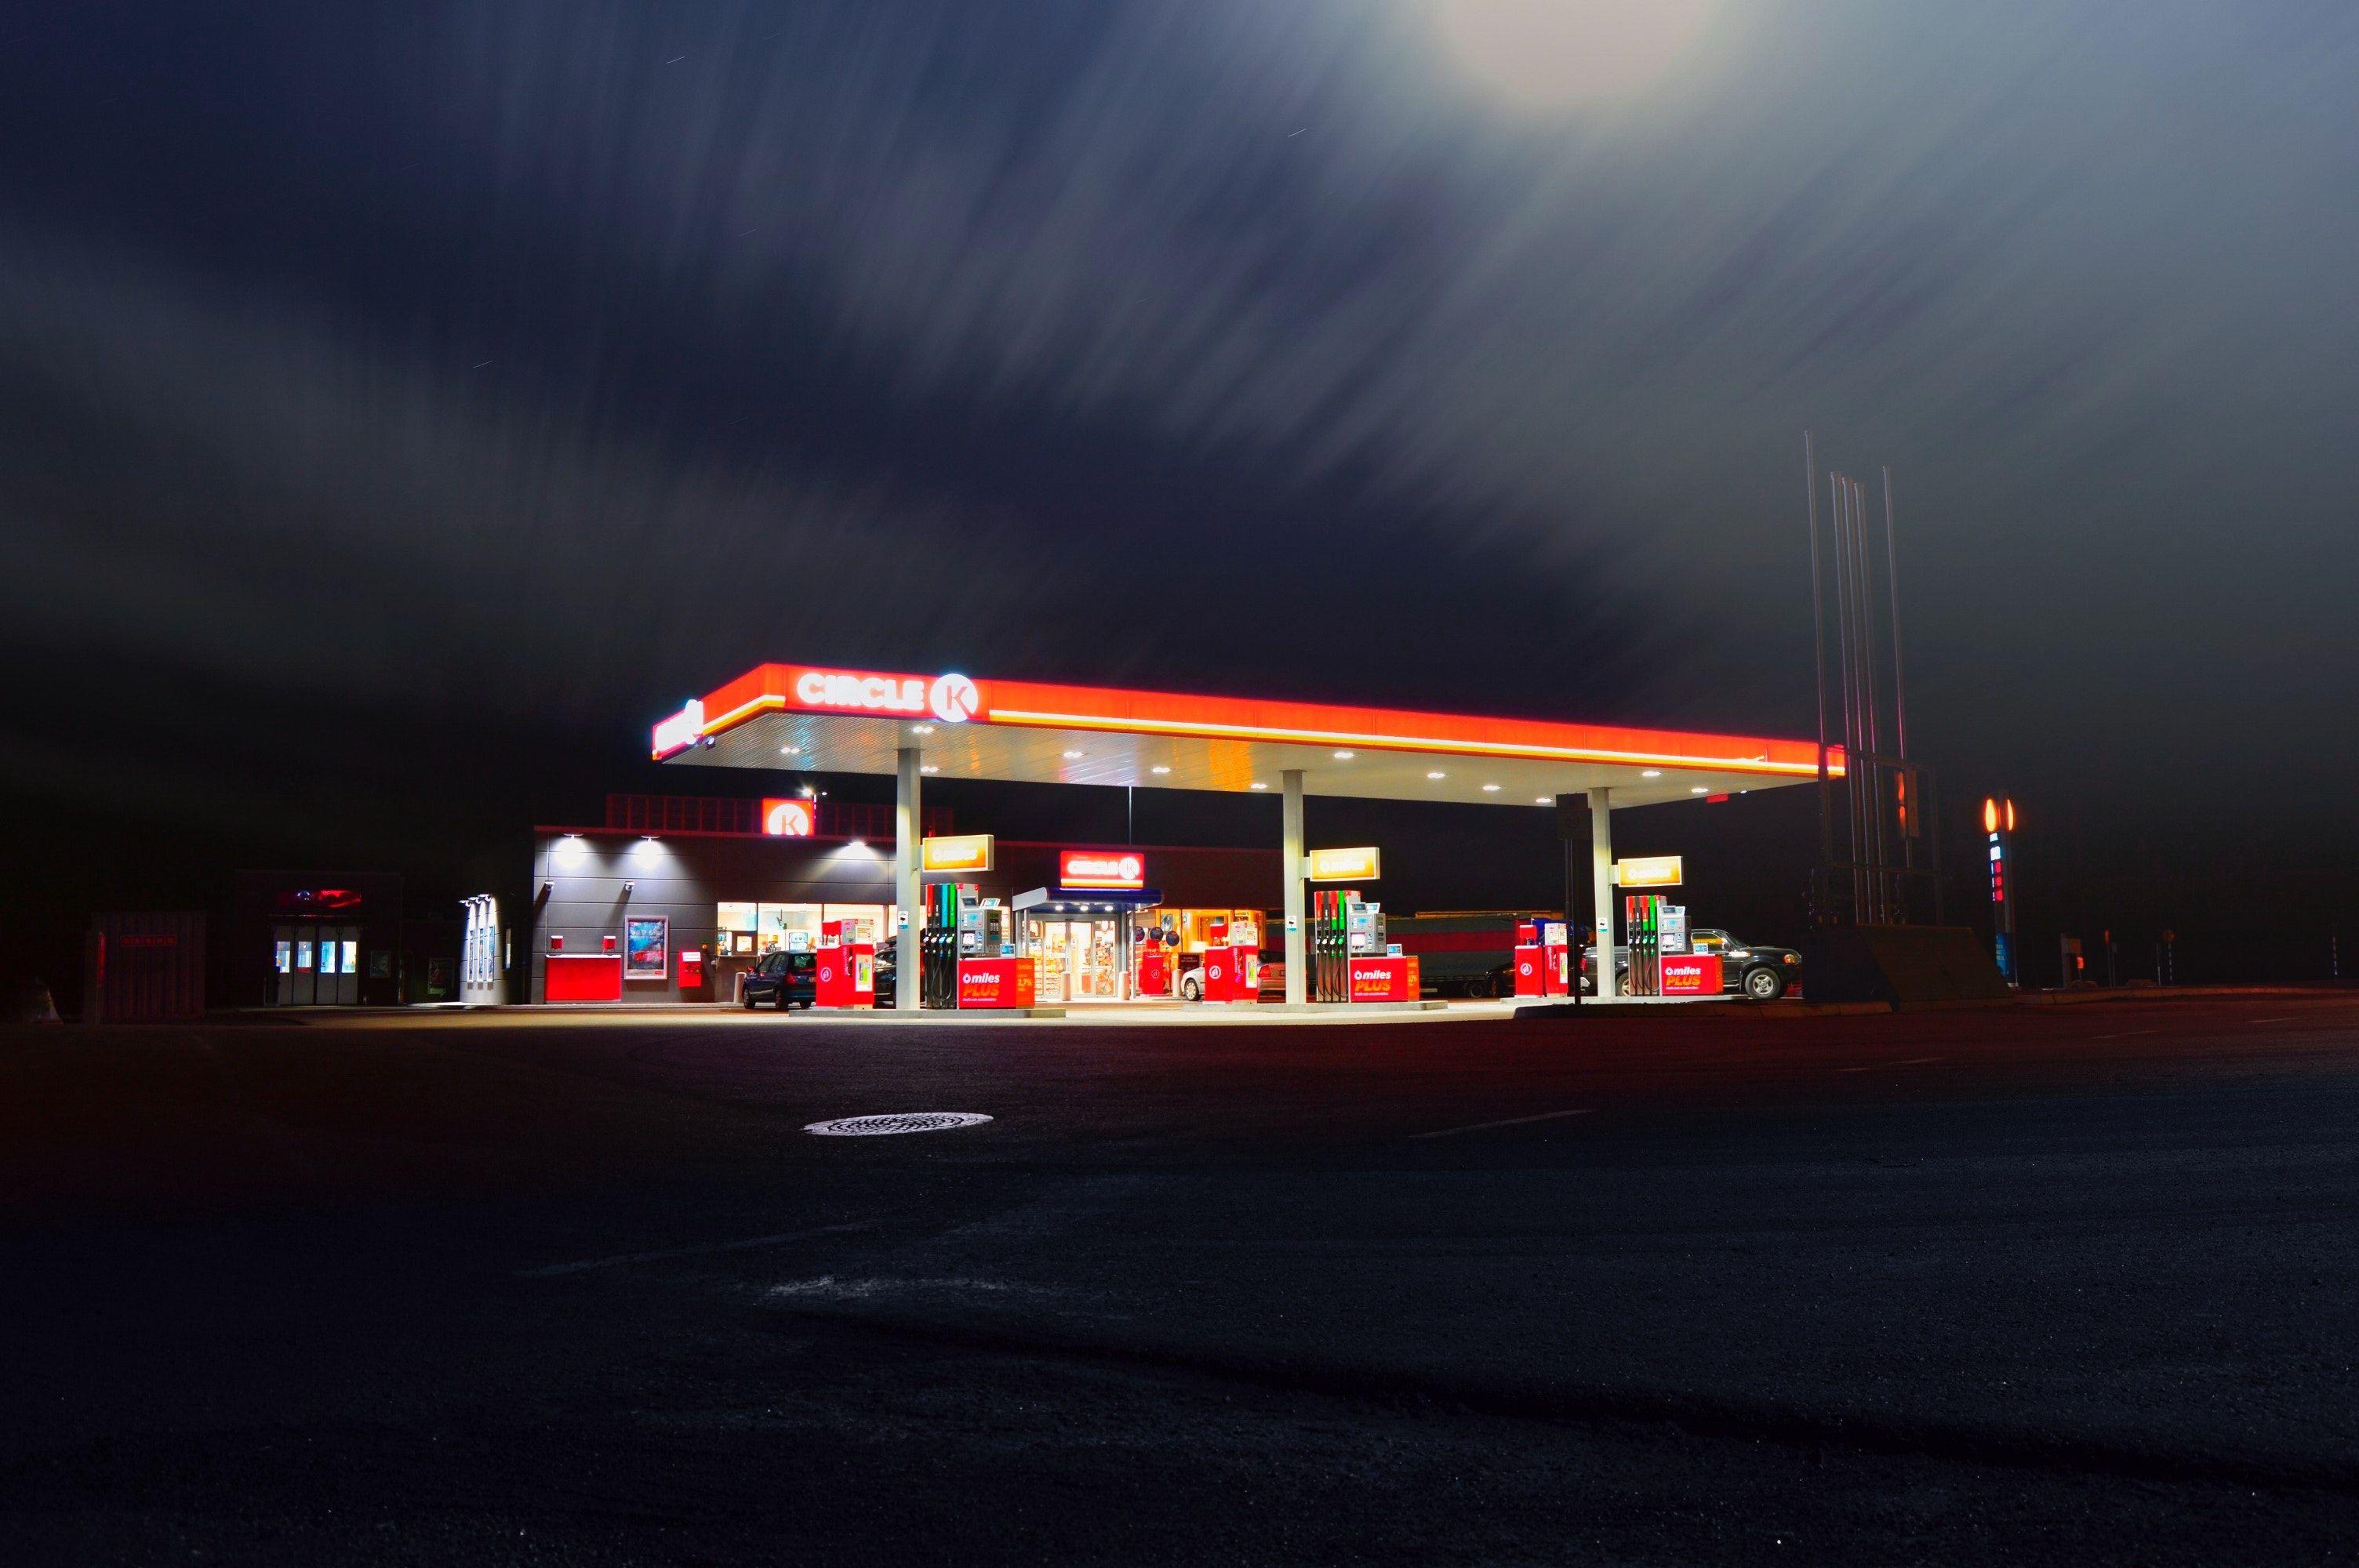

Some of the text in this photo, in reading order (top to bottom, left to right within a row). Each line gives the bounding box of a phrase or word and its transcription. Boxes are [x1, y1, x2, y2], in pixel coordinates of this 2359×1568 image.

[797, 673, 924, 710] CIRCLE
[1362, 969, 1392, 980] miles
[1673, 966, 1702, 975] miles
[971, 972, 1000, 984] miles
[1666, 975, 1701, 986] PLUS
[963, 984, 999, 996] PLUS
[1354, 980, 1391, 992] PLUS
